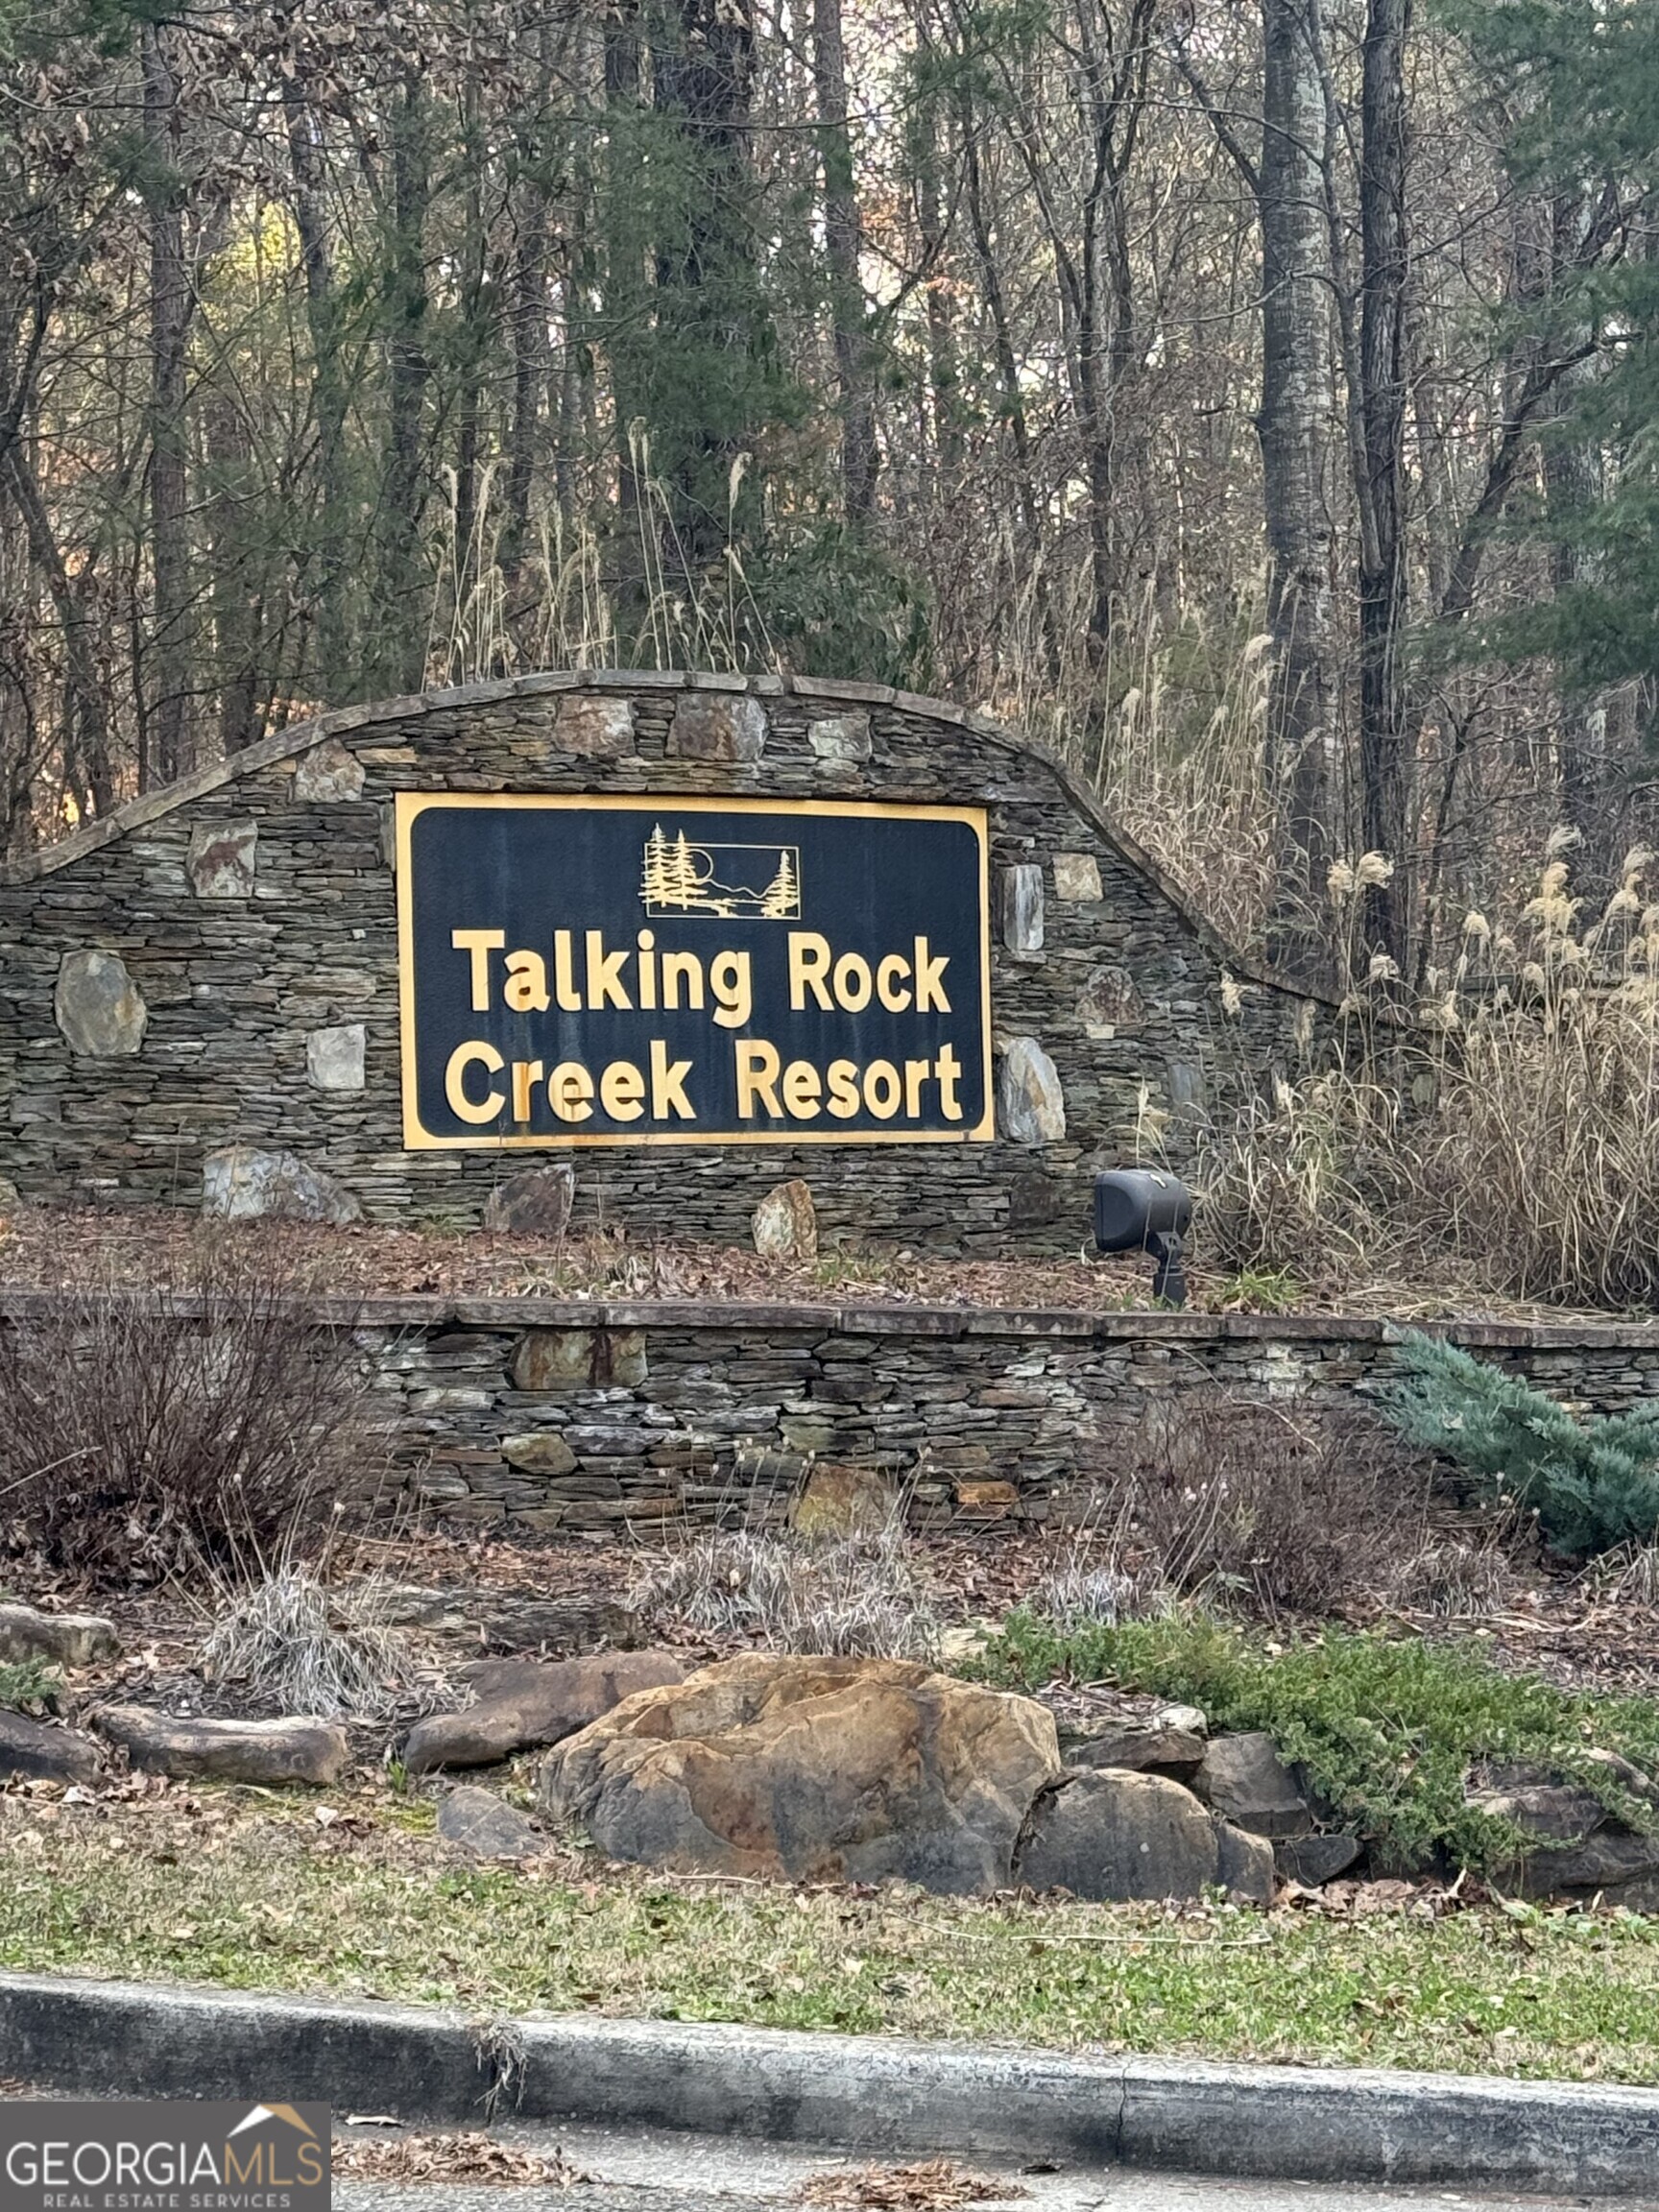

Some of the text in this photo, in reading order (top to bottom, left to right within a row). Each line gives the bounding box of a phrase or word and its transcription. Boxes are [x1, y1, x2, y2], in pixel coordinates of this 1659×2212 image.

[451, 928, 952, 1029] Talking Rock
[445, 1039, 964, 1124] Creek Resort
